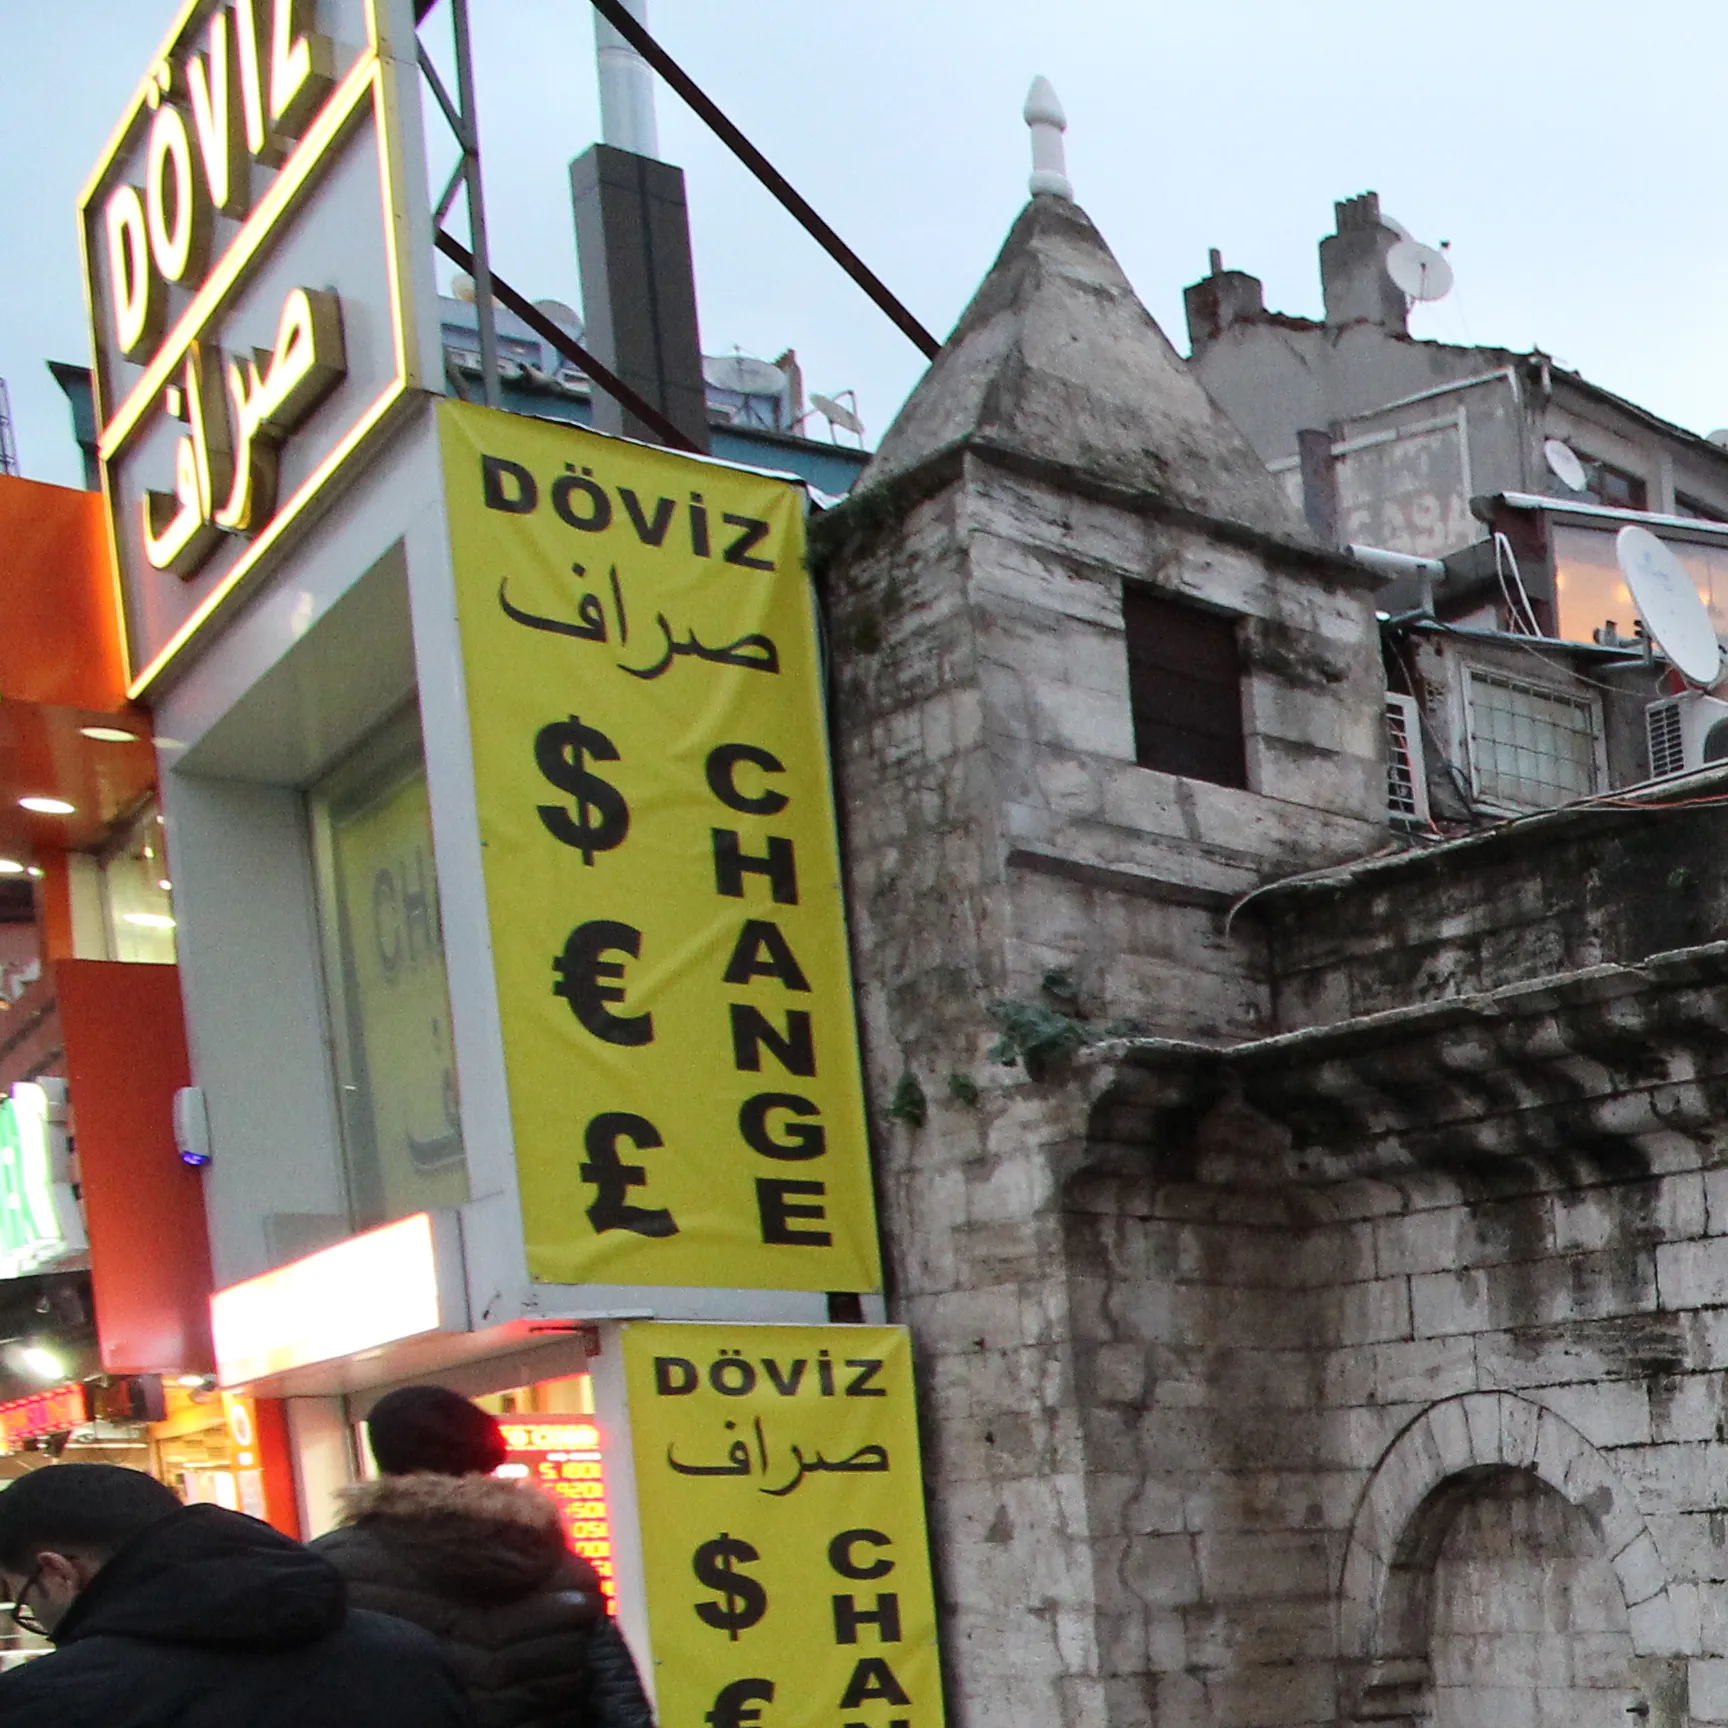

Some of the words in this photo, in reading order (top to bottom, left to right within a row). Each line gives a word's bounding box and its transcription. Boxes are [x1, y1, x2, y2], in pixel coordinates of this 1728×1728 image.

[141, 287, 318, 570] صراف
[481, 453, 777, 573] DÖVİZ
[498, 563, 780, 680] صراف
[534, 714, 630, 866] $
[552, 919, 654, 1047] €
[705, 742, 833, 1248] CHANGE
[579, 1111, 680, 1238] £
[654, 1349, 887, 1397] DÖVİZ
[667, 1416, 889, 1496] صراف
[692, 1532, 768, 1641] $
